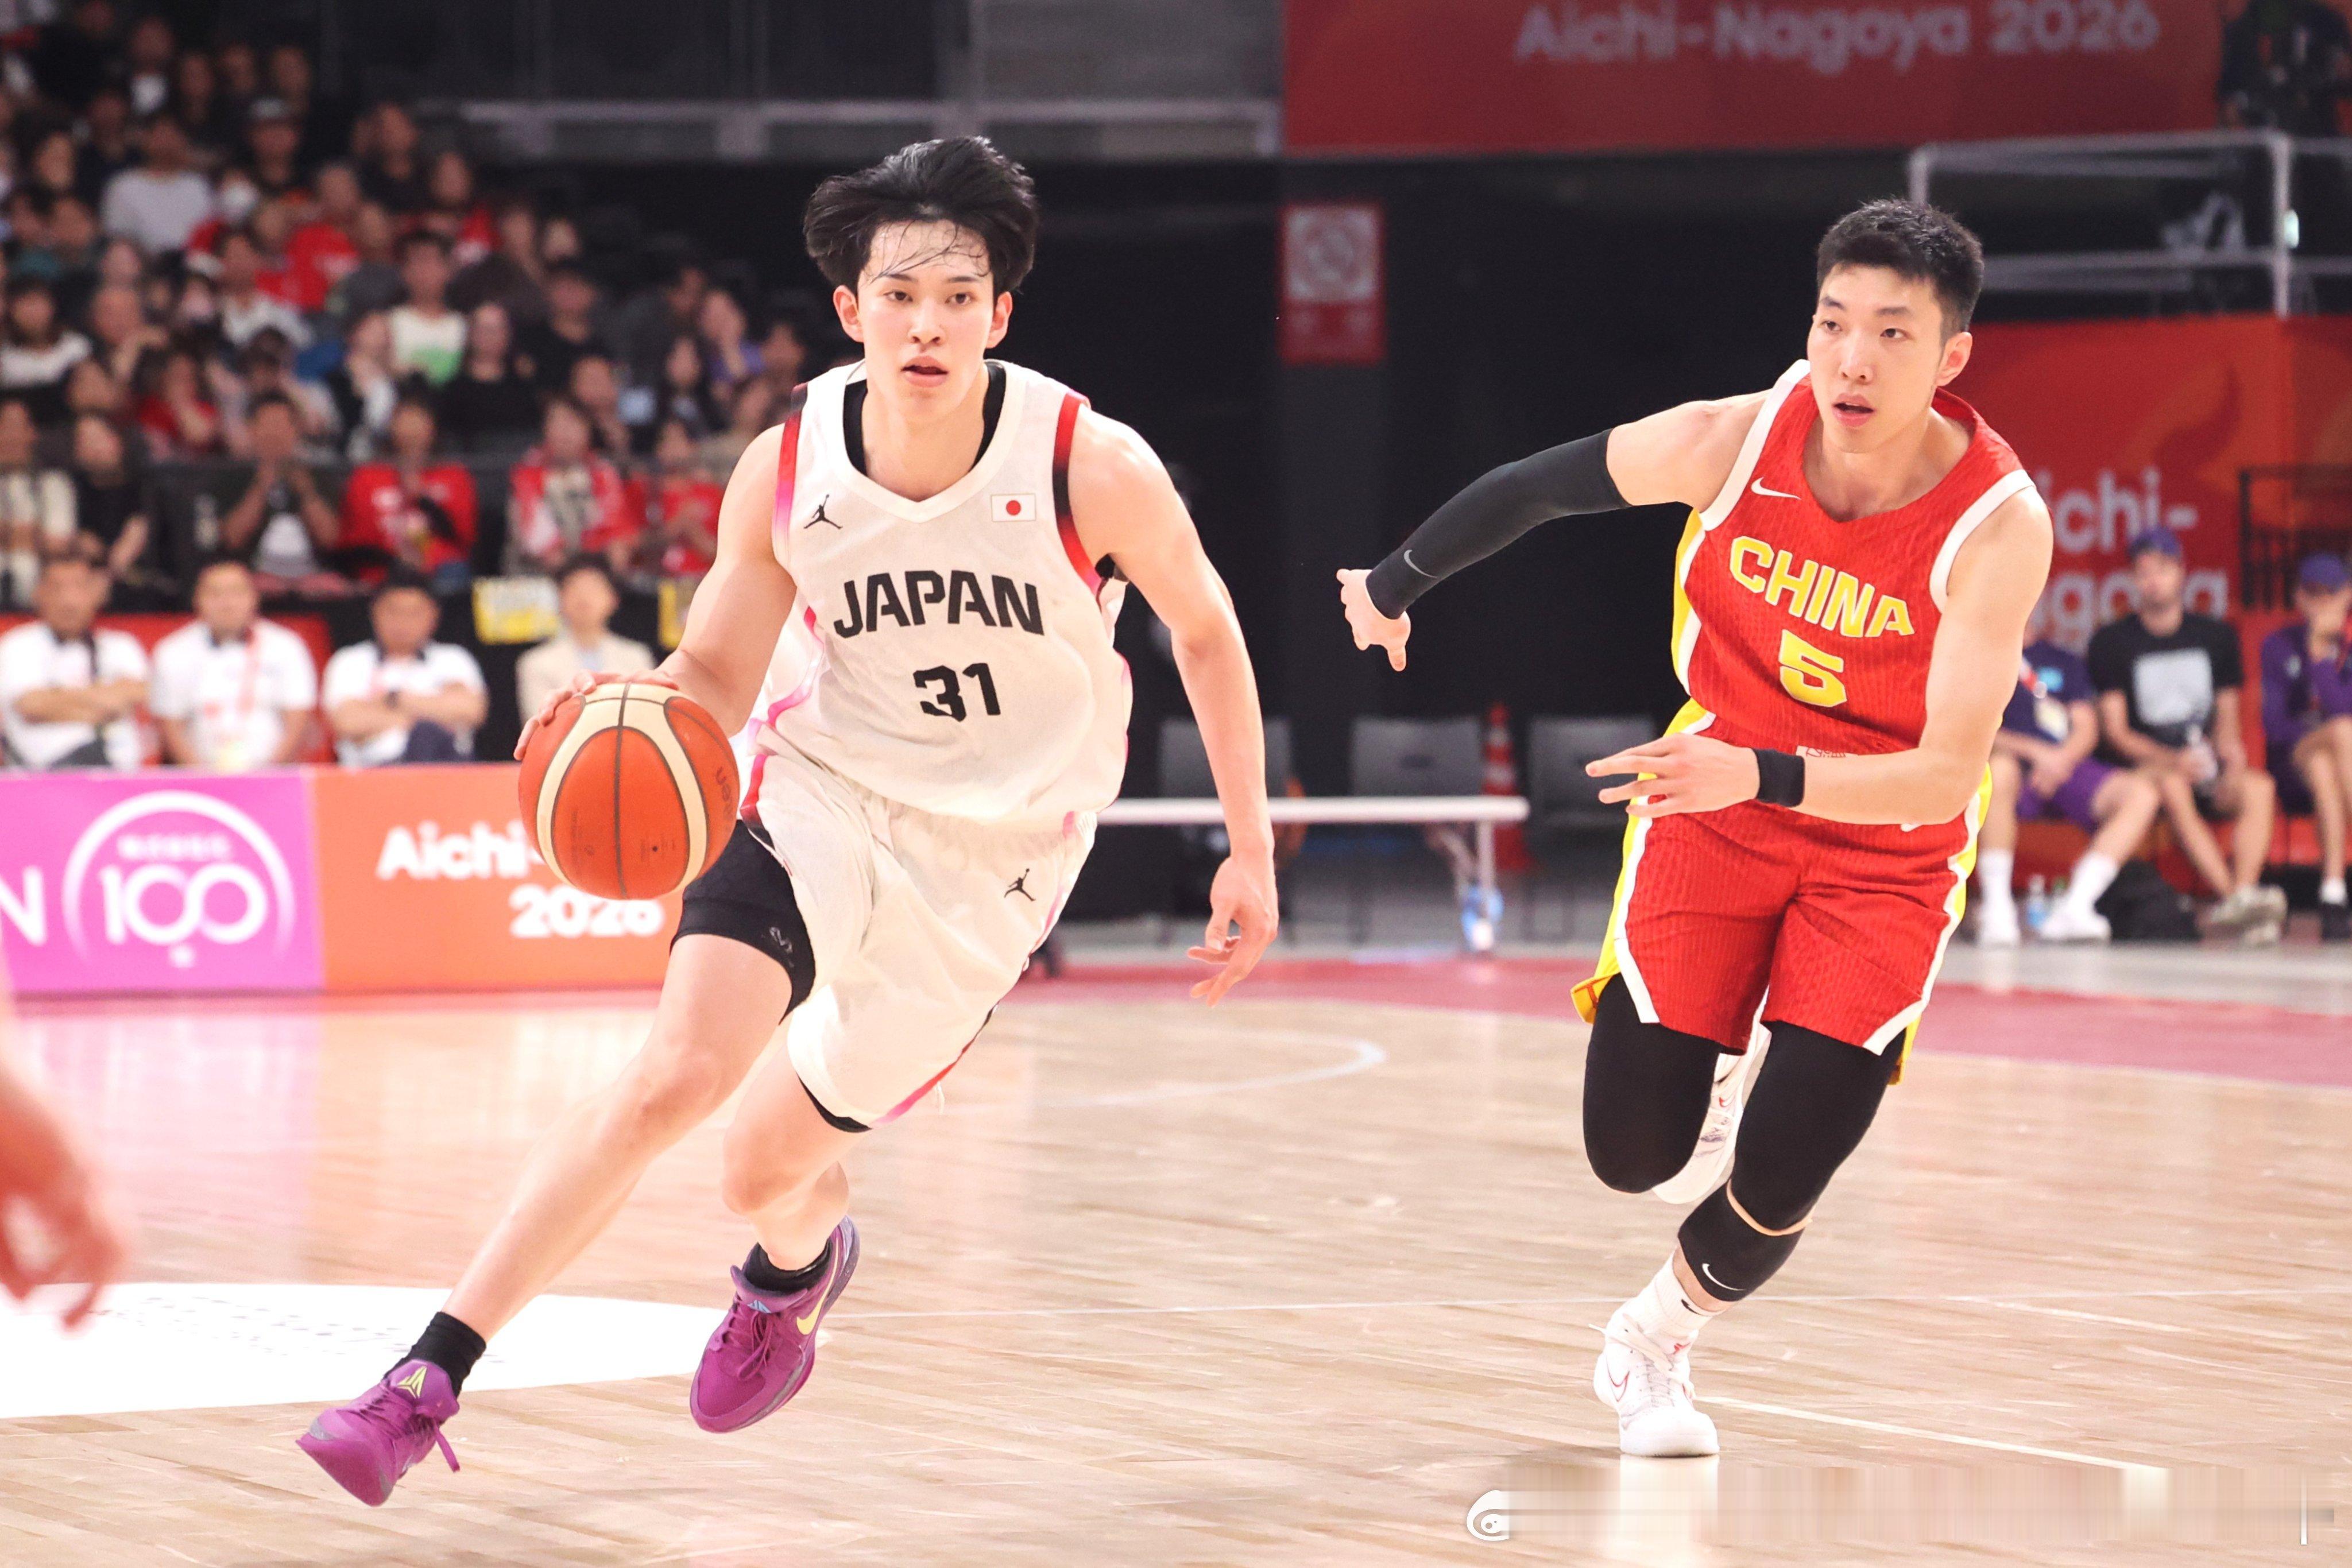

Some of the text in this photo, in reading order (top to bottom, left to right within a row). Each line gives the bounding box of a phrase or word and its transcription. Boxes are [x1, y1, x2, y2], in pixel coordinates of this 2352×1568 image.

[1515, 0, 2160, 75] Aichi-Nagoya 2026
[833, 570, 1045, 638] JAPAN
[1729, 536, 1915, 638] CHINA
[912, 663, 1001, 722] 31
[1778, 629, 1847, 707] 5
[509, 884, 665, 939] 2026
